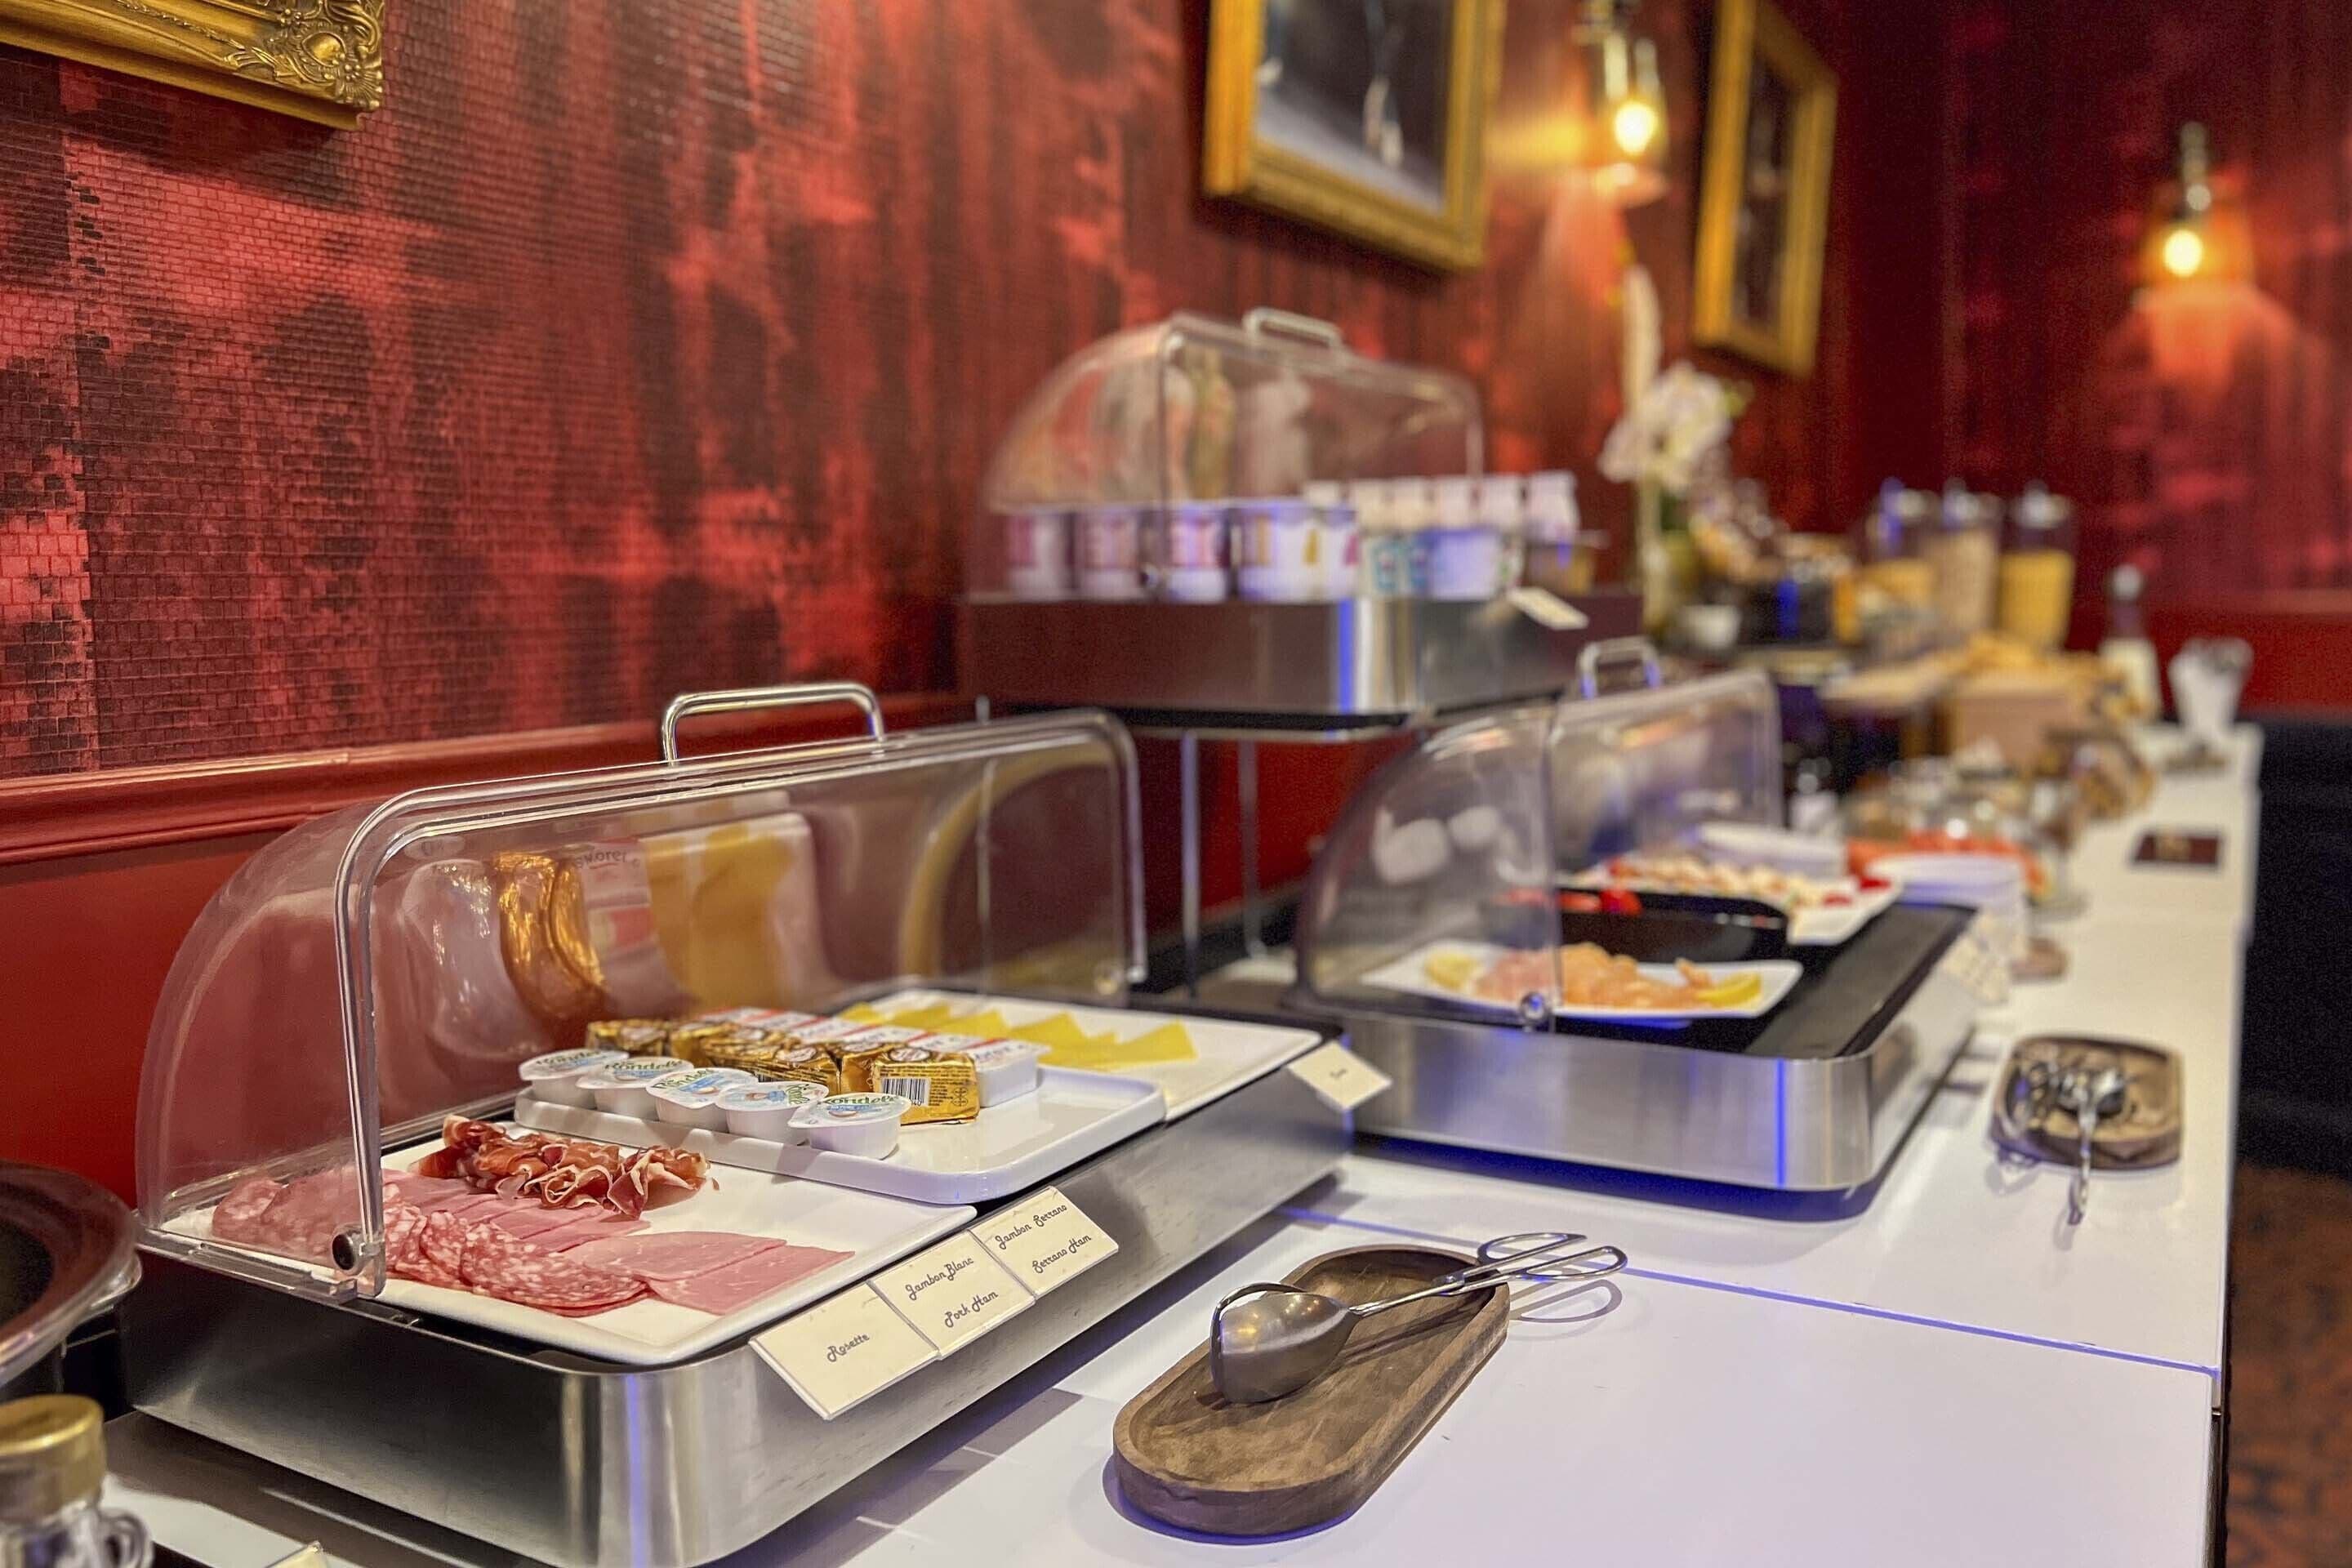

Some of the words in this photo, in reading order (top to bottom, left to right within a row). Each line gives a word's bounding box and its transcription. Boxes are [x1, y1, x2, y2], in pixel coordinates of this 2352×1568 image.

[995, 1223, 1031, 1250] Jambon
[1033, 1205, 1067, 1227] Serrano
[1031, 1249, 1068, 1274] Serrano
[1068, 1235, 1092, 1254] Ham
[905, 1272, 947, 1301] Jambon
[943, 1258, 974, 1281] Blanc
[944, 1303, 971, 1328] Pork
[972, 1291, 999, 1312] Ham
[826, 1334, 870, 1362] Rosette
